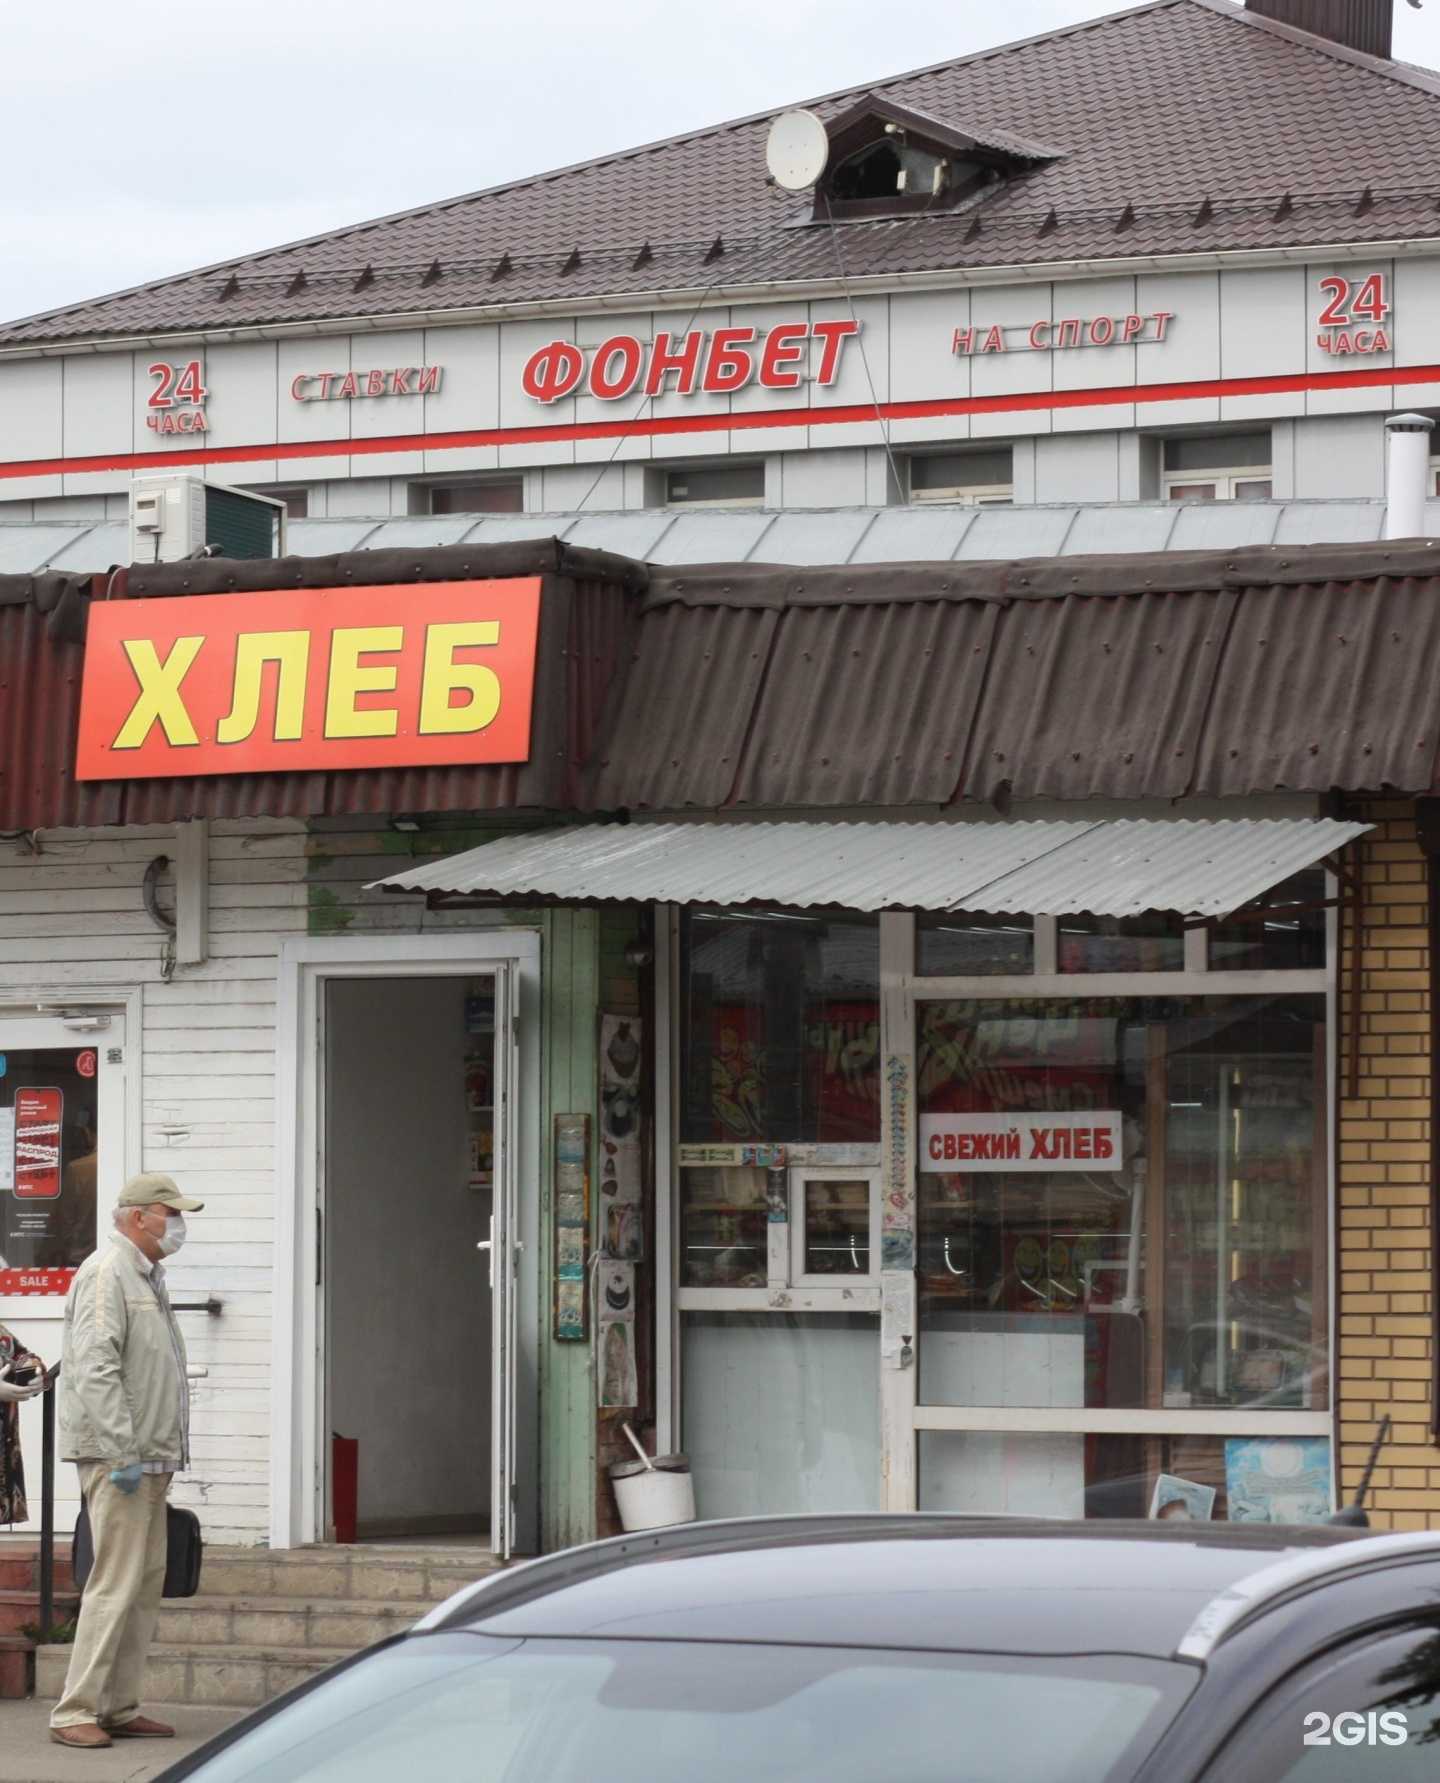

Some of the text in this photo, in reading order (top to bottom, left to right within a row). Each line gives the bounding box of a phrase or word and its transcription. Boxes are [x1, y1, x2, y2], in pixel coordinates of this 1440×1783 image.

[1317, 273, 1389, 327] 24
[951, 312, 1173, 355] НА СПОРТ
[1317, 329, 1390, 354] ЧАСА
[522, 320, 860, 405] ФОНБЕТ
[148, 360, 206, 408] 24
[289, 366, 443, 402] СТАВКИ
[146, 411, 208, 434] ЧАСА
[110, 620, 502, 751] ХЛЕБ
[928, 1127, 1114, 1161] СВЕЖИЙ ХЛЕБ
[19, 1275, 49, 1287] SALE
